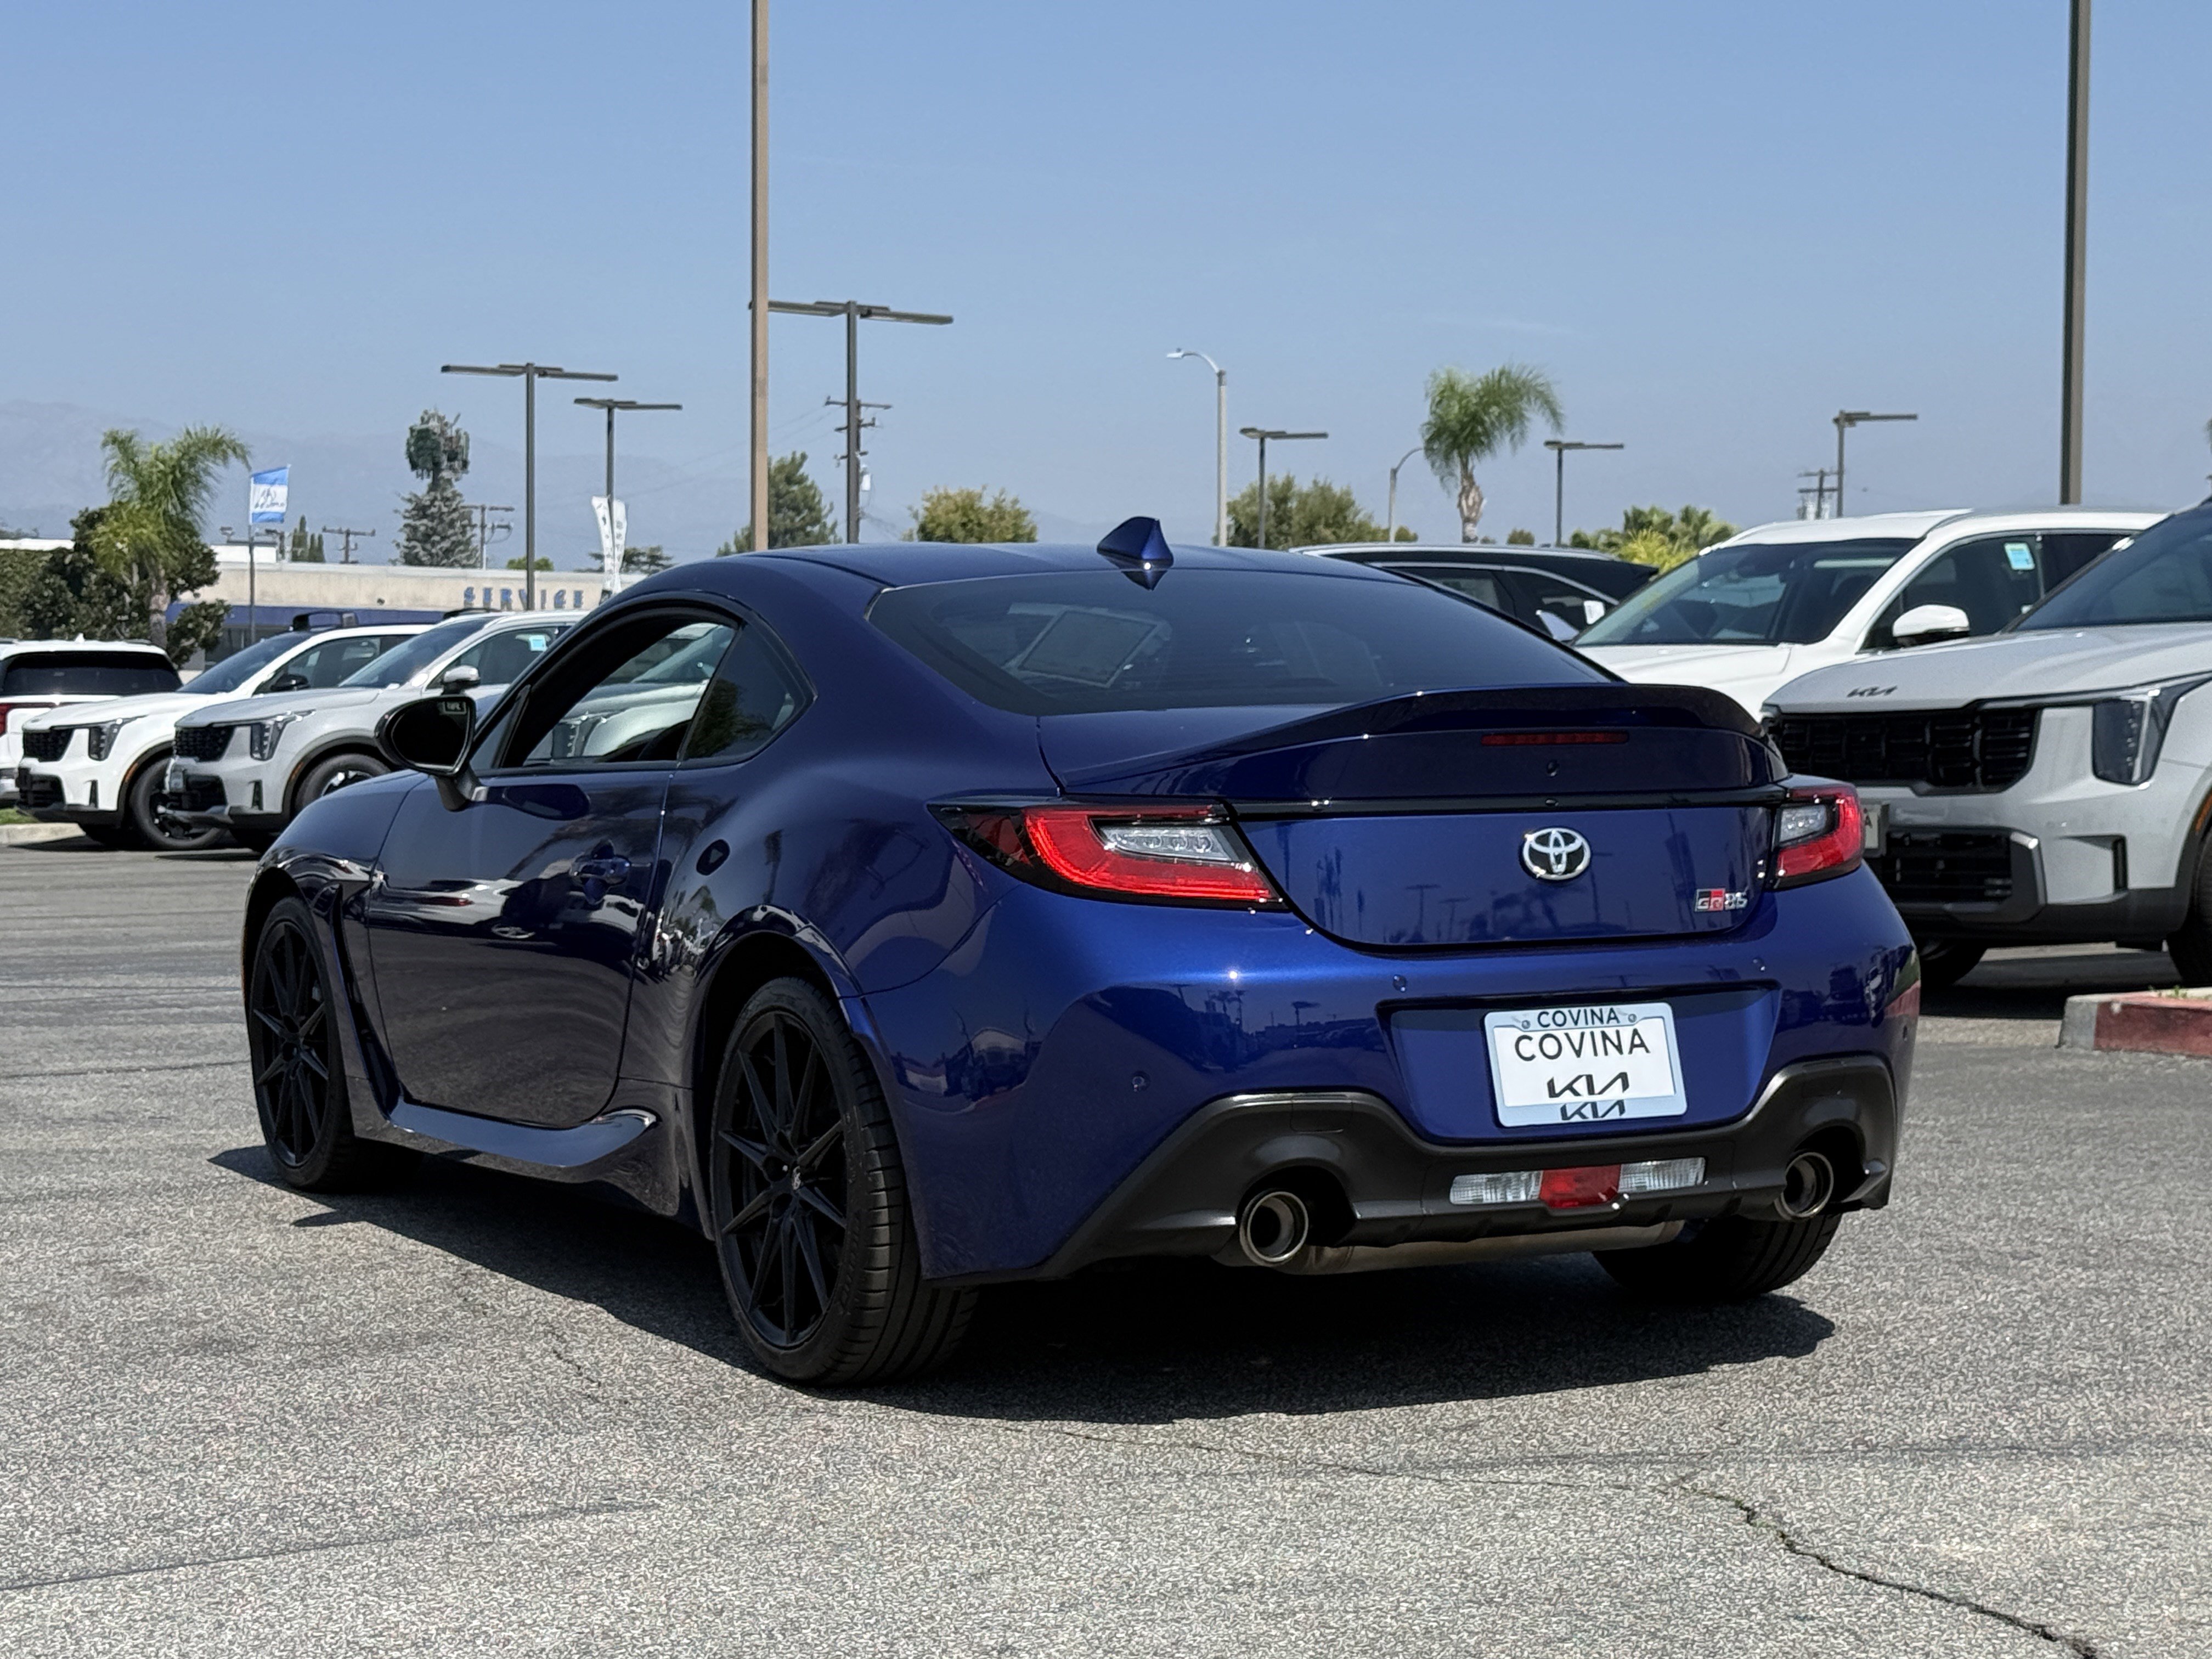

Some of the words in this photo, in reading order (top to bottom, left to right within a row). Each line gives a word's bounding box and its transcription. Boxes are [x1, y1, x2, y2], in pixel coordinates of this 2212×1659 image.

[1537, 1007, 1620, 1028] COVINA
[1515, 1028, 1650, 1061] COVINA
[1547, 1072, 1629, 1098] KIA
[1560, 1099, 1626, 1120] KIA
